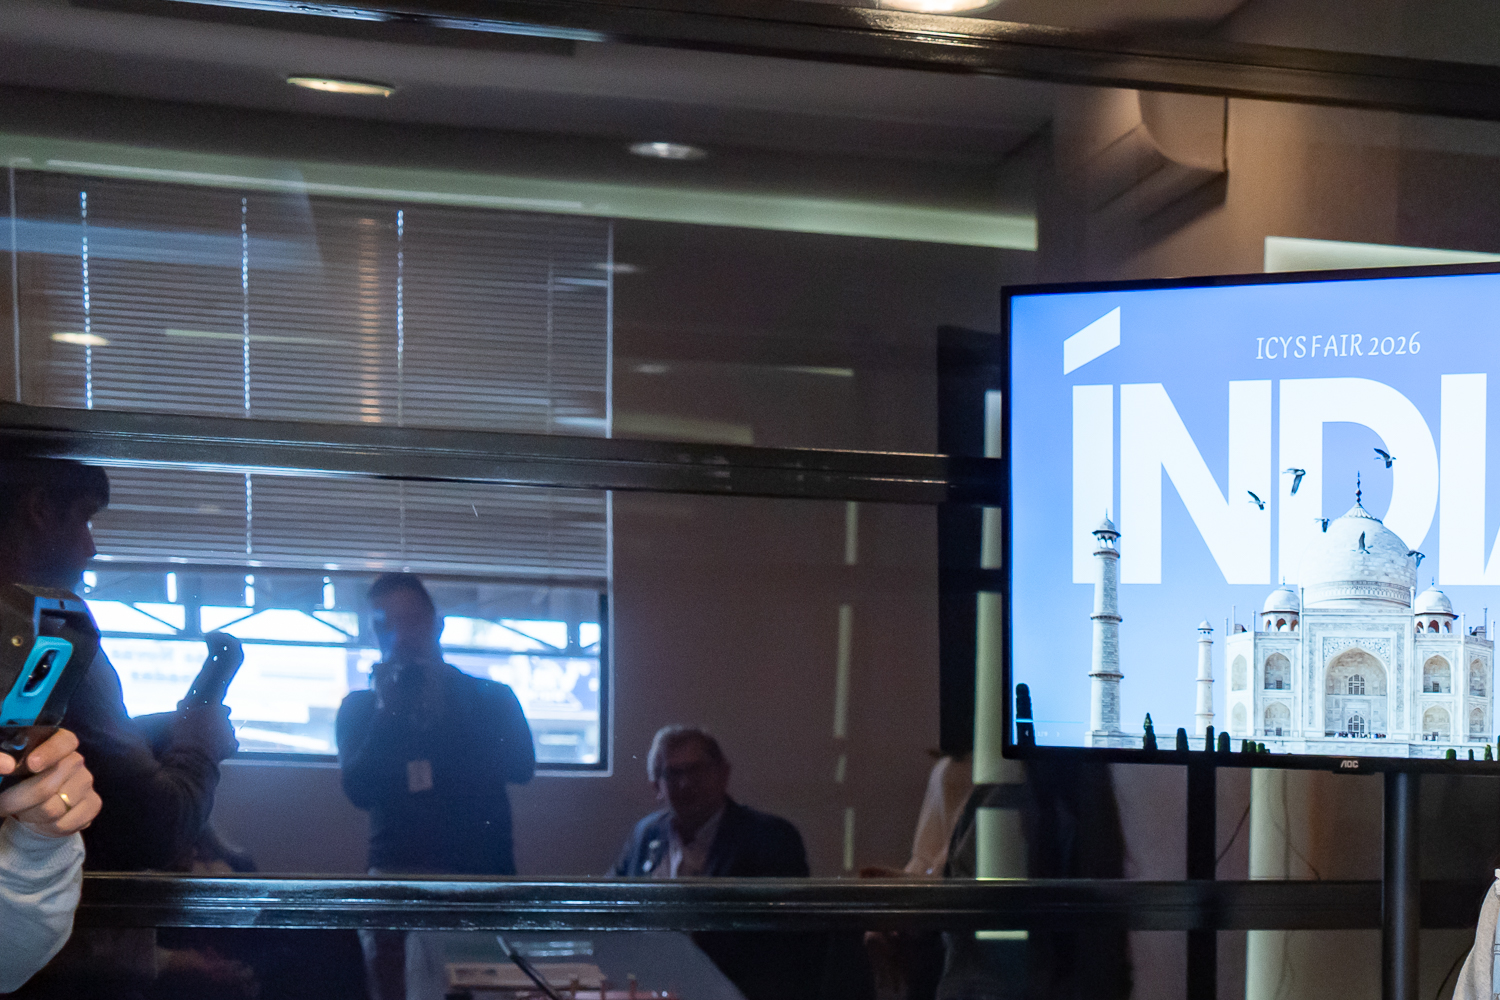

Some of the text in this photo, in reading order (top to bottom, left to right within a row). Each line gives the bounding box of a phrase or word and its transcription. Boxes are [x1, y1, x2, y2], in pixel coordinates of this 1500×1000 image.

[1255, 331, 1421, 360] ICYS FAIR 2026
[1340, 760, 1359, 769] AOC
